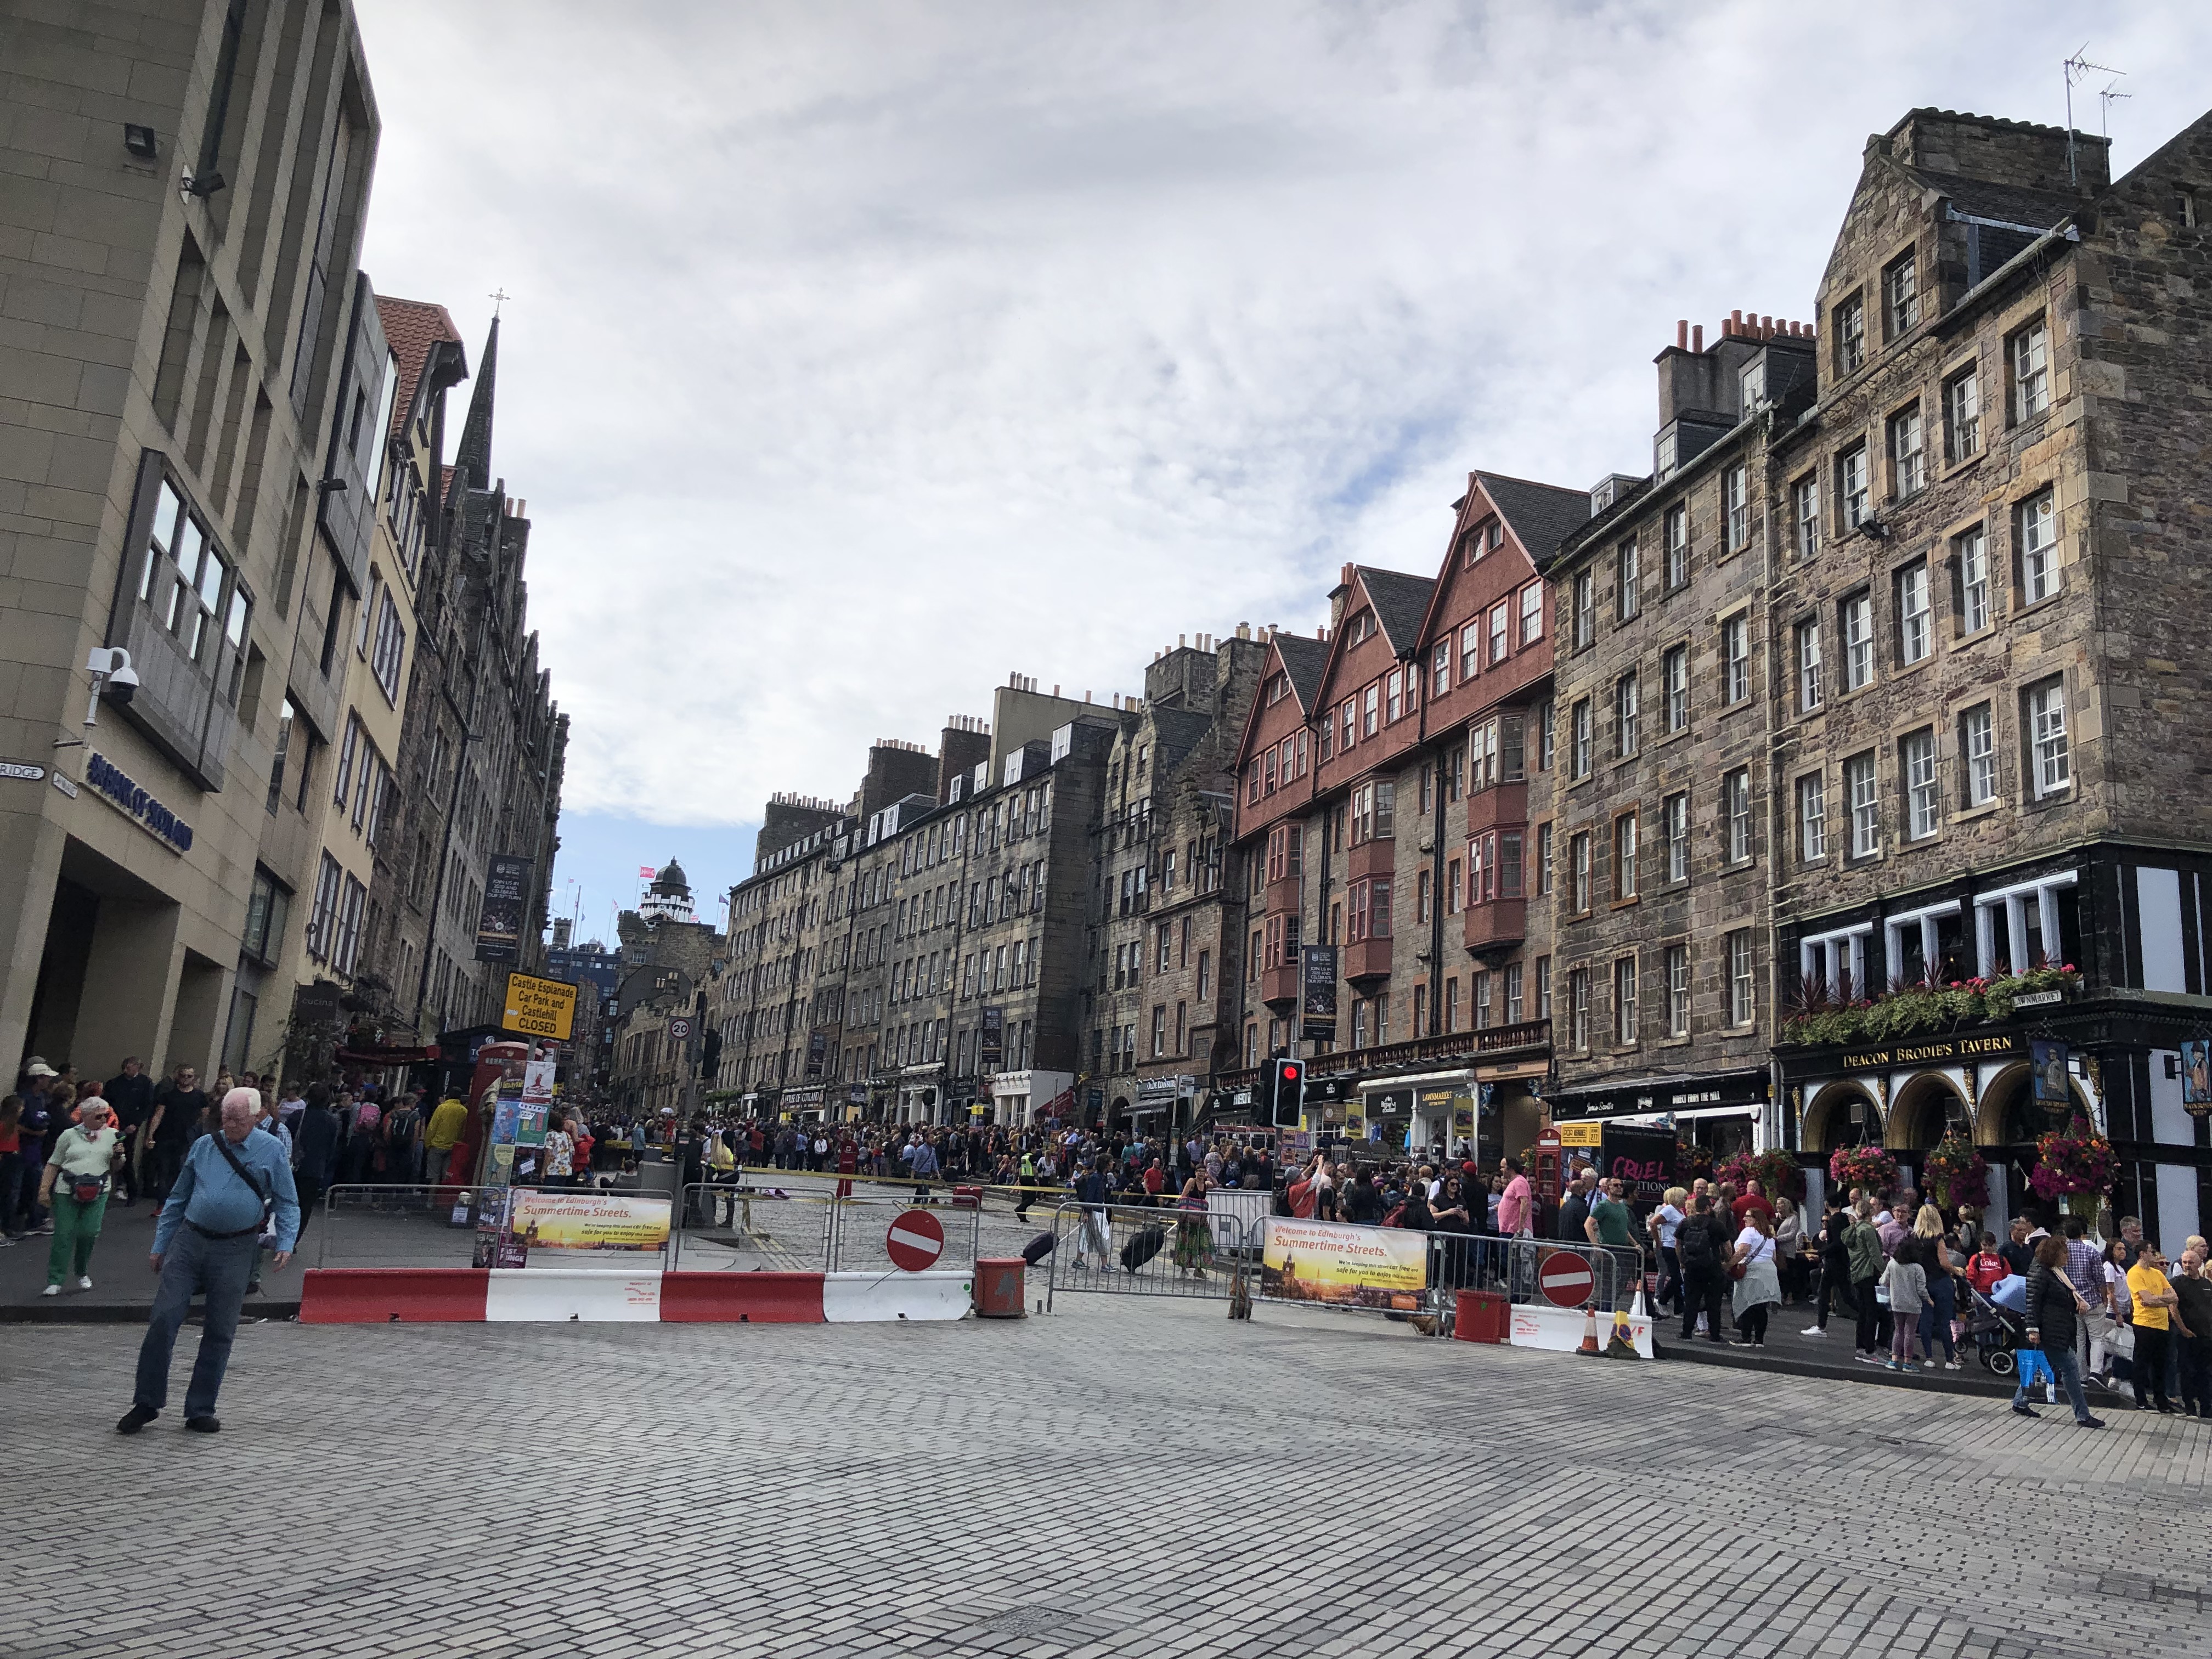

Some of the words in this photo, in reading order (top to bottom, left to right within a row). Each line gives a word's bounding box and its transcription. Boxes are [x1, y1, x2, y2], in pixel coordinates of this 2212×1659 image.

[512, 975, 536, 990] Castle
[538, 981, 574, 998] Esplanade
[302, 997, 334, 1007] cucina
[518, 990, 532, 1003] Car
[533, 994, 550, 1006] Park
[551, 999, 565, 1009] and
[2013, 991, 2059, 1006] LAWNMARKET
[522, 1005, 557, 1021] Castlehill
[518, 1018, 557, 1034] CLOSED
[674, 1024, 688, 1033] 20
[1844, 1051, 1889, 1068] DEACON
[1897, 1043, 1953, 1062] BRODIE'S
[1958, 1036, 2012, 1054] TAVERN
[802, 1092, 820, 1102] COTLAND
[1423, 1091, 1453, 1101] LAWNMARKET
[1613, 1156, 1669, 1180] CRUEL
[566, 1198, 607, 1206] Edinburgh's
[523, 1205, 590, 1216] Summertime
[592, 1207, 632, 1218] Streets.
[1275, 1226, 1308, 1235] Welcome
[1318, 1229, 1361, 1241] Edinburgh's
[1274, 1235, 1344, 1252] Summertime
[1346, 1243, 1387, 1257] Streets.
[1980, 1259, 1999, 1267] Coke
